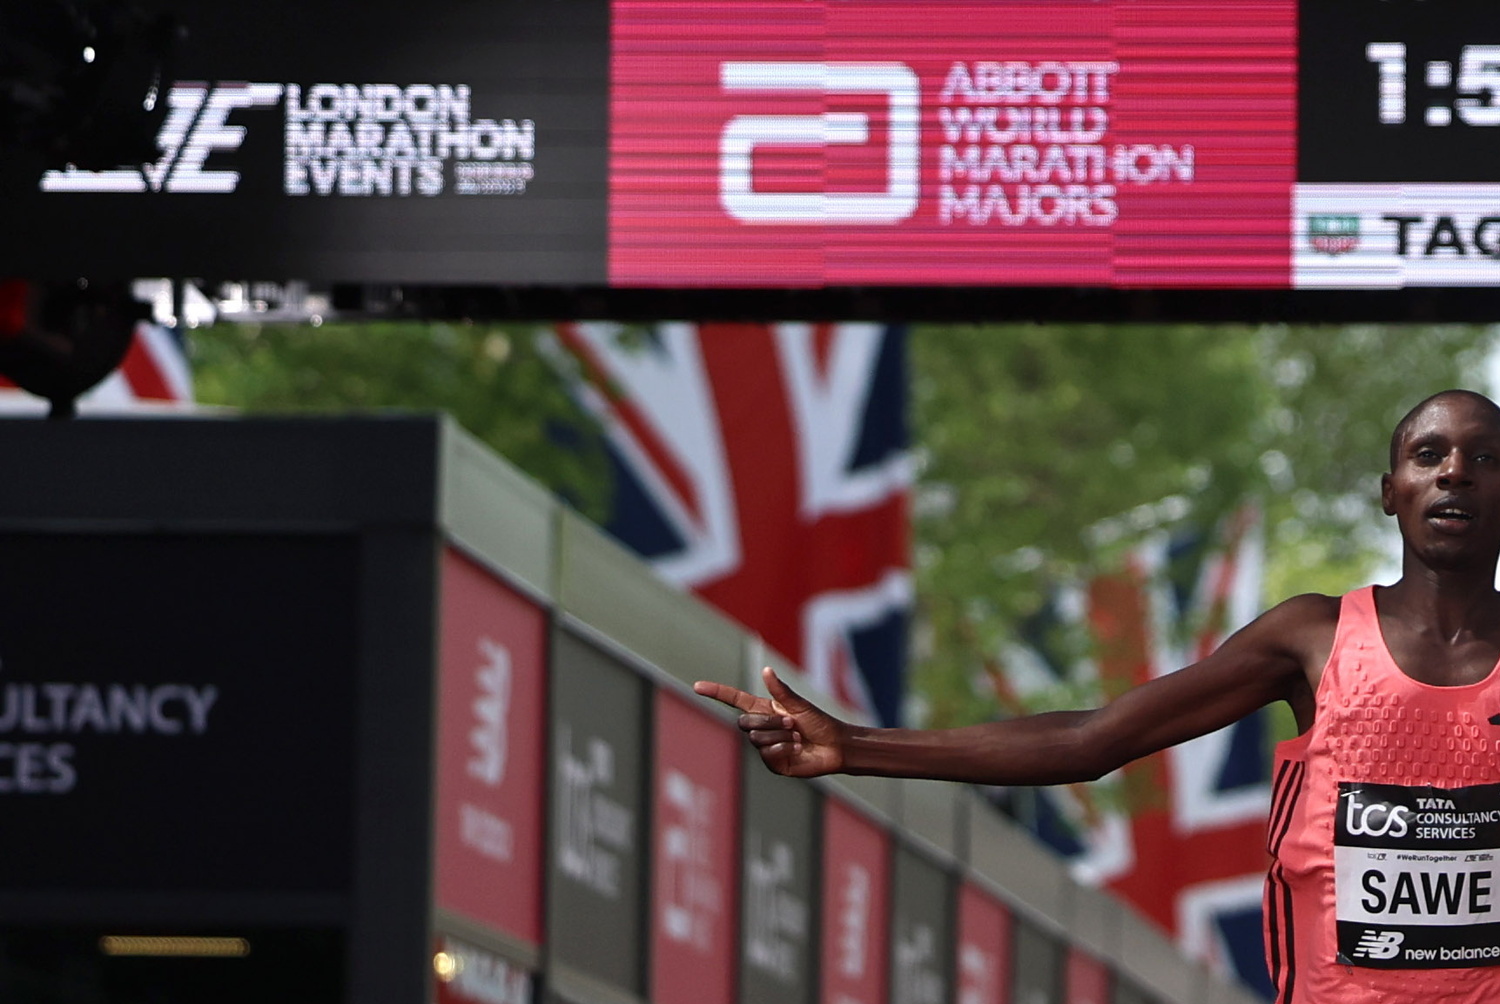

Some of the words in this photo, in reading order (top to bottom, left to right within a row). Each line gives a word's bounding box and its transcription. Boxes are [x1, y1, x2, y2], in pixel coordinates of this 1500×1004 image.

[940, 62, 1119, 102] ABBOTT
[285, 83, 471, 122] LONDON
[285, 119, 535, 160] MARATHON
[940, 106, 1108, 144] WORLD
[285, 159, 445, 196] EVENTS
[940, 144, 1194, 183] MARATHON
[940, 184, 1119, 225] MAJORS
[1346, 793, 1409, 837] tcs
[1416, 798, 1456, 810] TATA
[1416, 827, 1476, 839] SERVICES
[1361, 869, 1492, 915] SAWE
[1405, 948, 1437, 960] new
[1440, 945, 1500, 960] balance
